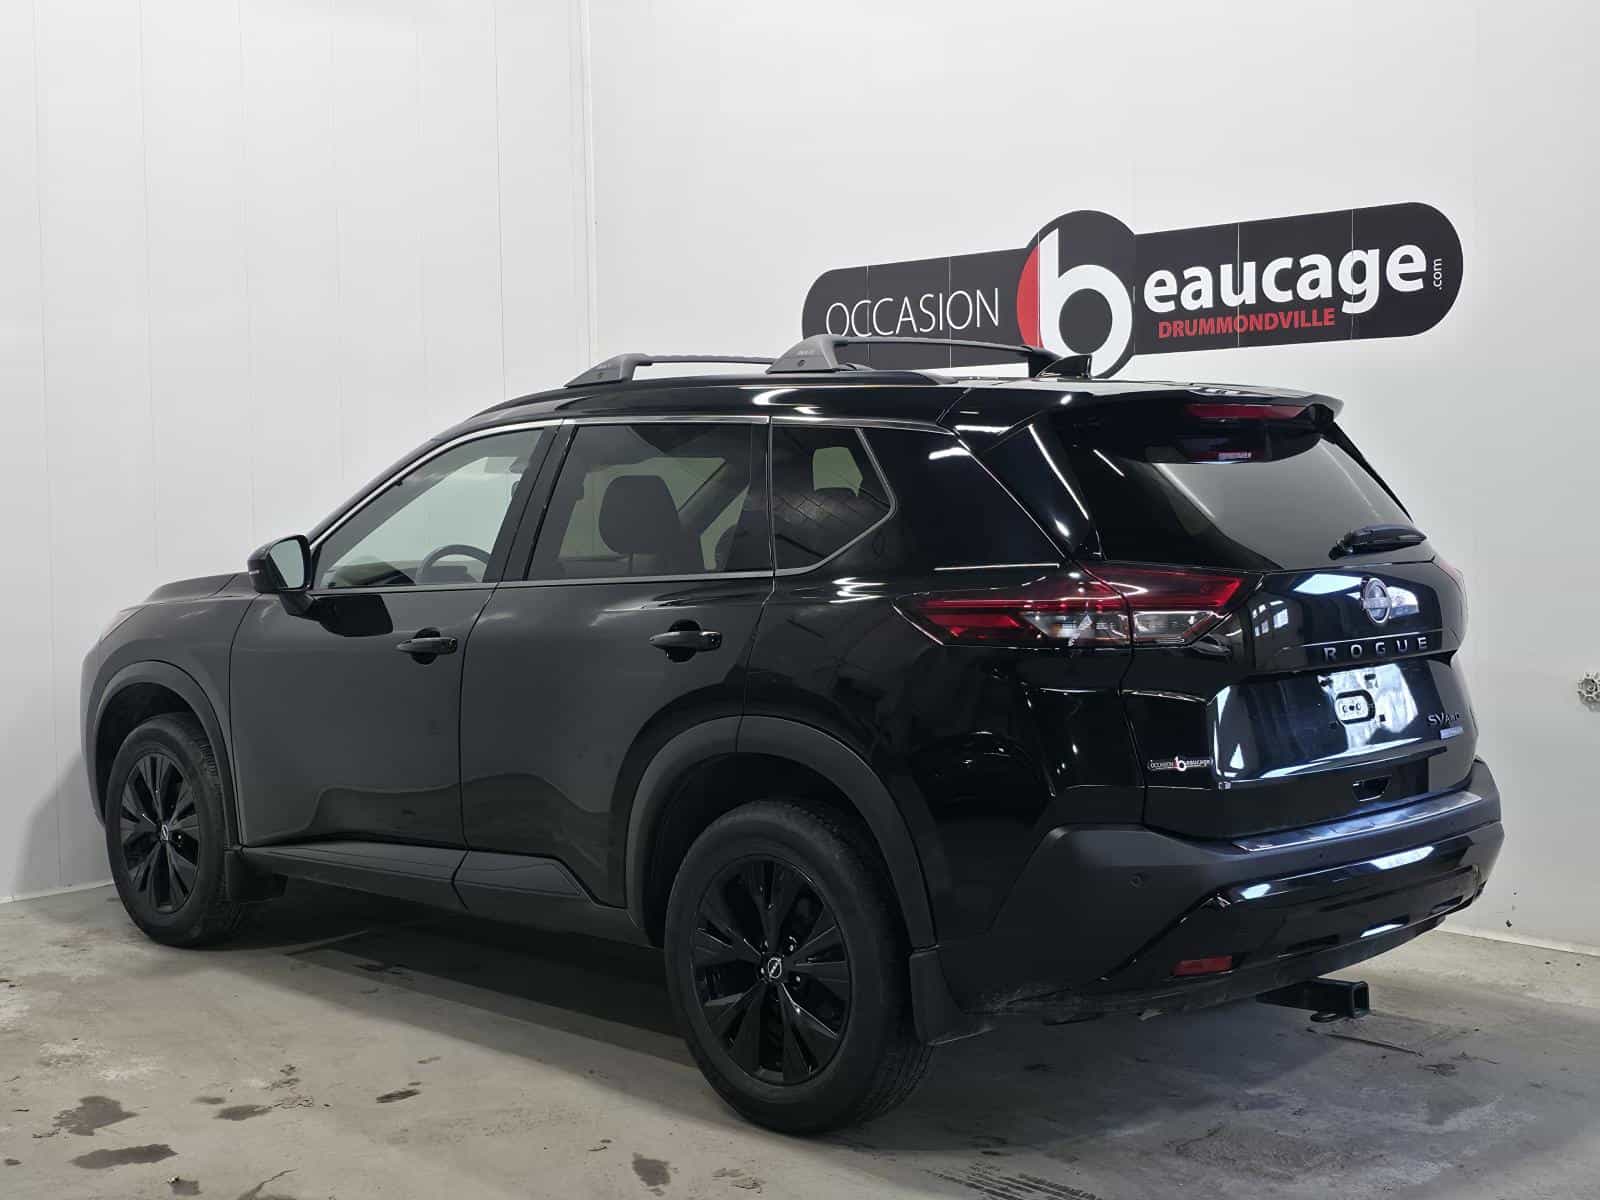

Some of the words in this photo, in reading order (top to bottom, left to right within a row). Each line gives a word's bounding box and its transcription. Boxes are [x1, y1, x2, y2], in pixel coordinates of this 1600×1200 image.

[826, 288, 999, 337] OCCASION
[1158, 307, 1336, 339] DRUMMONDVILLE
[1323, 637, 1428, 661] ROGUE
